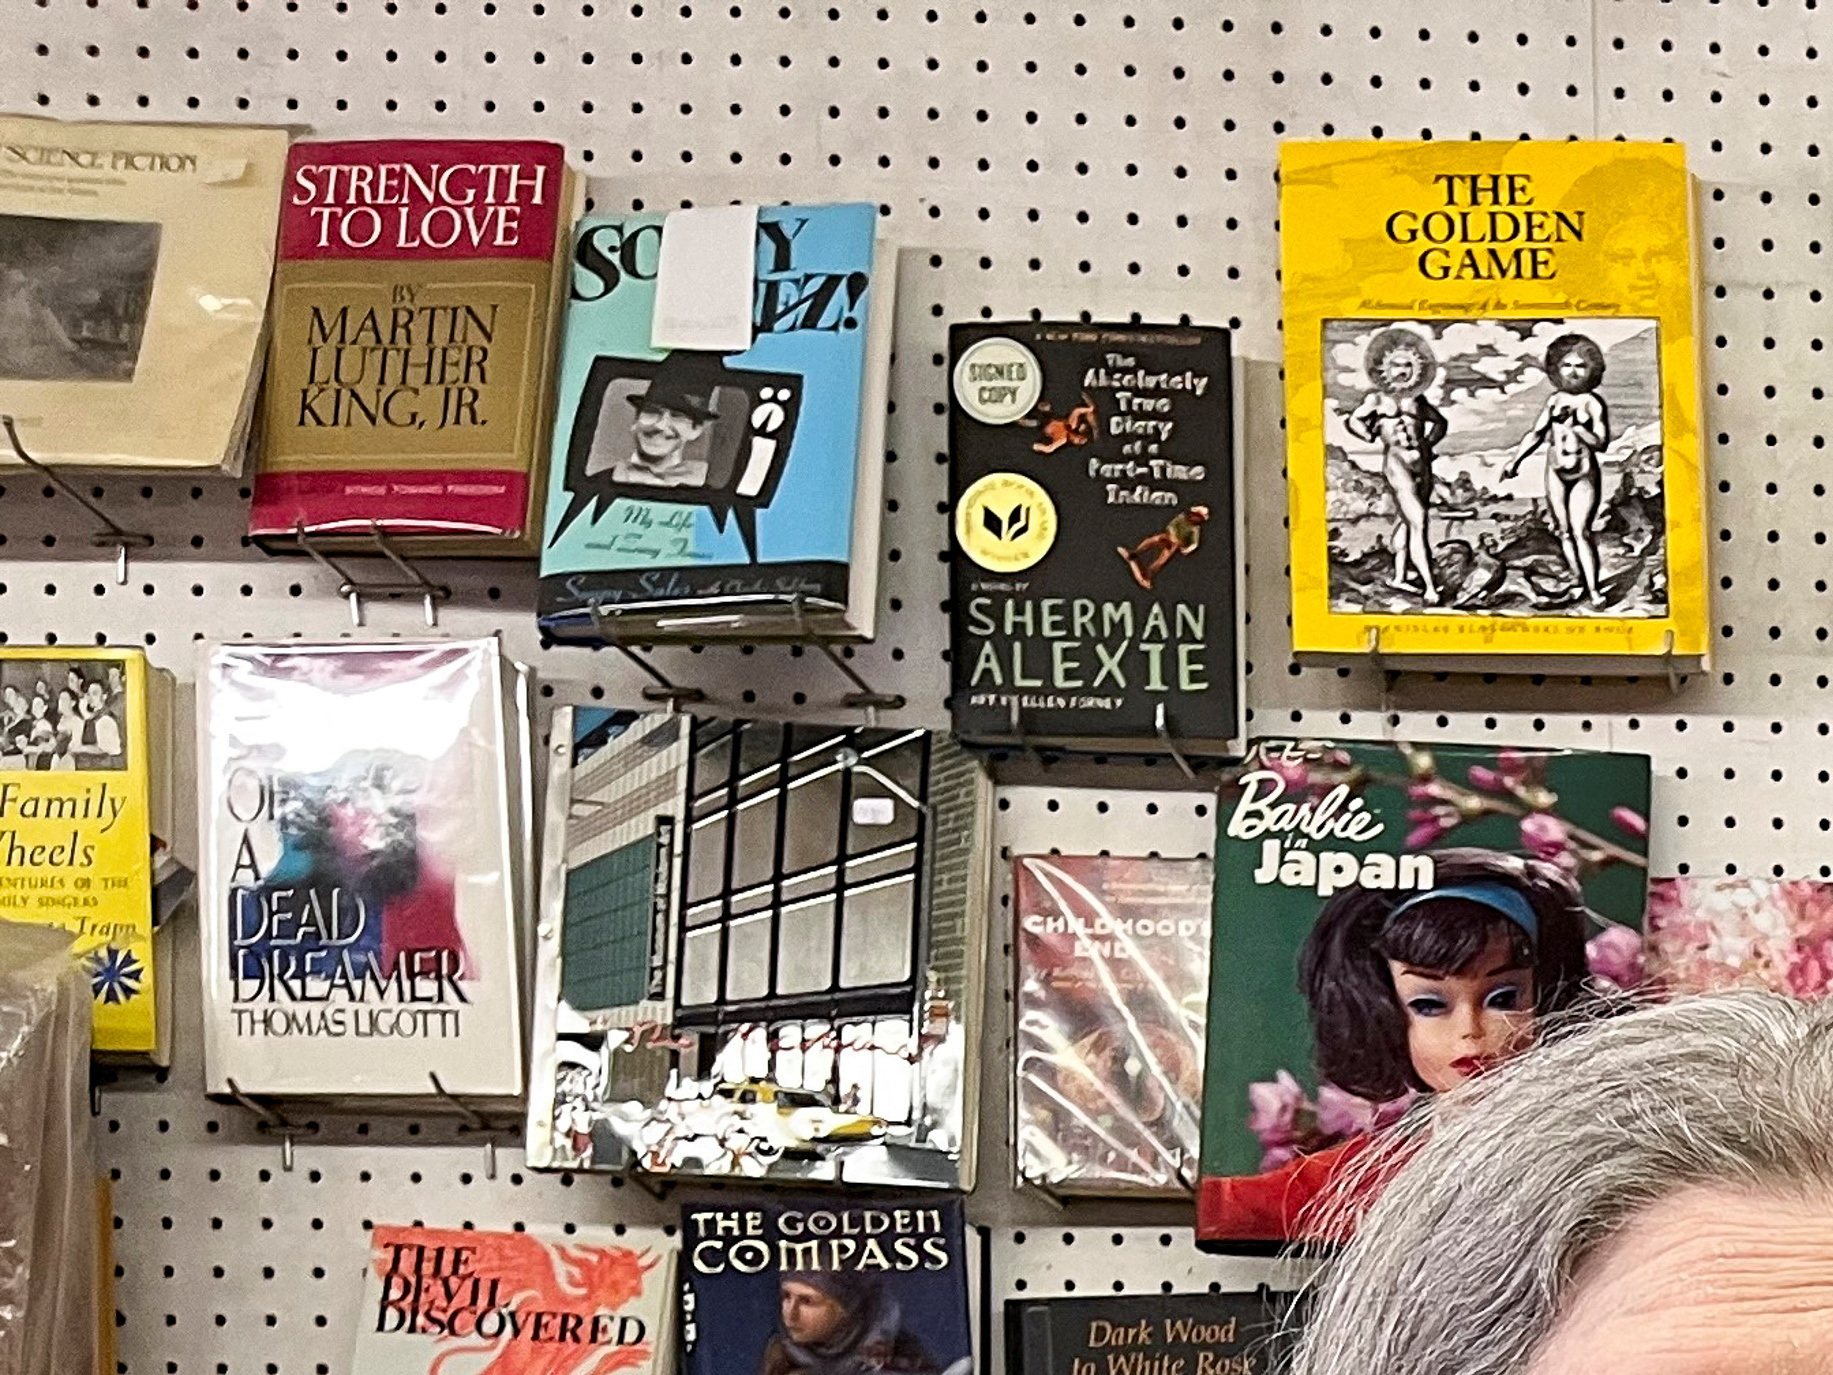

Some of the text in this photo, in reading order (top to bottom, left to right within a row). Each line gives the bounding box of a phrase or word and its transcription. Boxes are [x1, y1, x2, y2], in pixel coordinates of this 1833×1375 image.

[110, 152, 198, 173] FICTION
[292, 163, 547, 207] STRENGTH
[1434, 173, 1534, 208] THE
[311, 206, 521, 248] TO LOVE
[1386, 210, 1585, 245] GOLDEN
[1417, 246, 1558, 282] GAME
[392, 284, 421, 302] BY
[307, 304, 500, 346] MARTIN
[308, 344, 489, 386] LUTHER
[969, 362, 1028, 383] SIGNED
[1105, 353, 1136, 368] The
[977, 385, 1021, 406] COPY
[1083, 367, 1209, 397] Absolutely
[297, 387, 488, 430] KING, JR.
[1114, 391, 1172, 414] True
[1109, 416, 1173, 441] Diary
[1087, 457, 1207, 481] Part-Time
[1105, 483, 1178, 507] Indian
[967, 597, 1206, 641] SHERMAN
[970, 639, 1209, 691] ALEXIE
[0, 783, 127, 834] Family
[1227, 772, 1385, 843] Barbie
[1284, 831, 1307, 850] in
[232, 845, 263, 886] A
[1254, 838, 1434, 896] Japan
[232, 889, 366, 947] DEAD
[1073, 940, 1130, 958] END
[231, 948, 469, 1006] DREAMER
[232, 1009, 463, 1039] THOMAS LIGOTTI
[691, 1209, 942, 1237] THE GOLDEN
[384, 1242, 478, 1279] THE
[692, 1238, 950, 1274] COMPASS
[380, 1273, 505, 1309] DEVIL
[375, 1304, 646, 1349] DISCOVERED
[1087, 1316, 1237, 1350] Dark Wood
